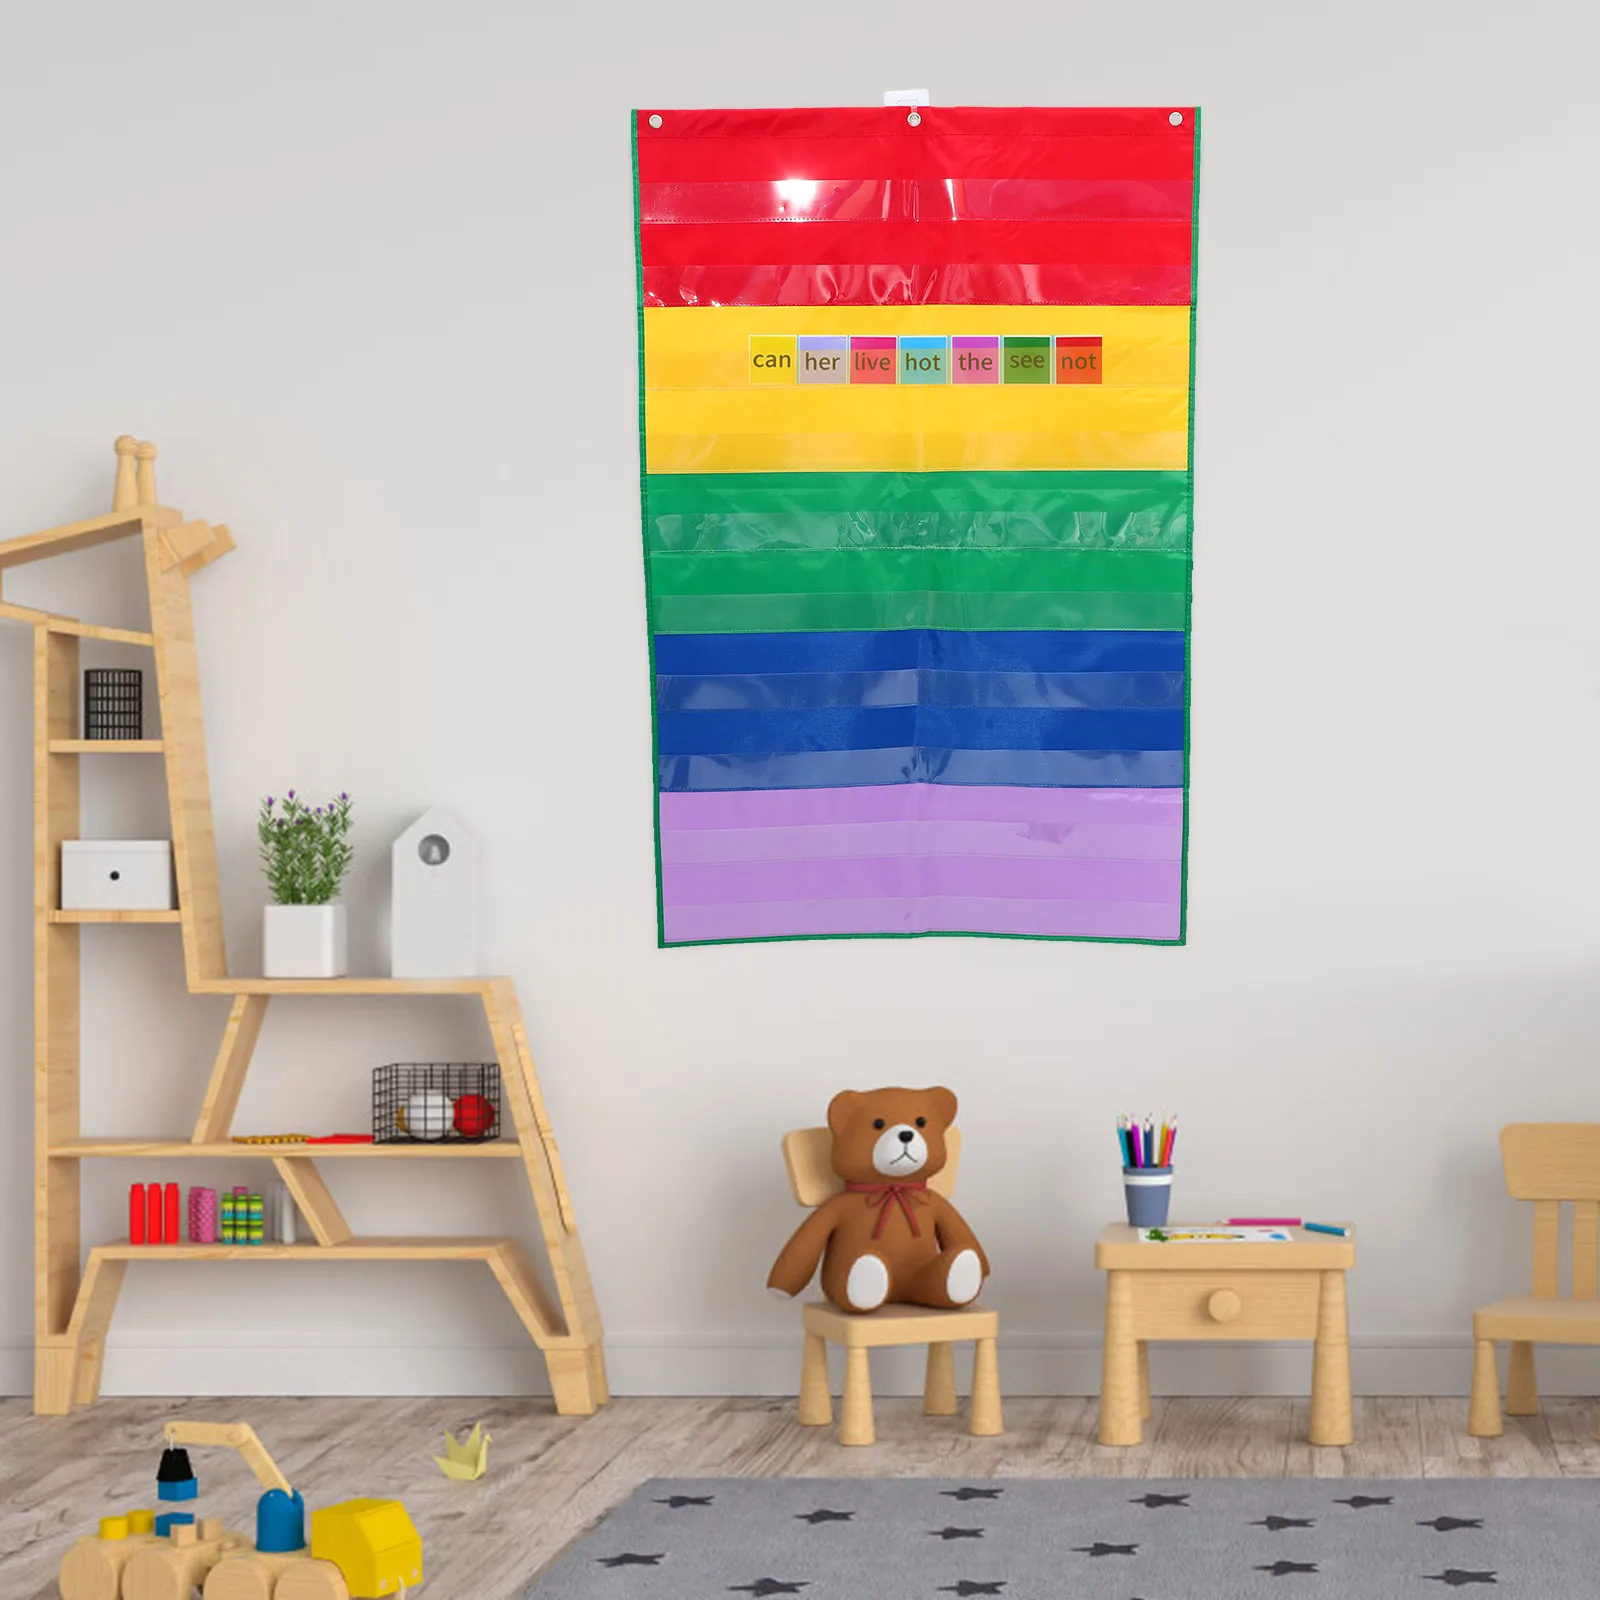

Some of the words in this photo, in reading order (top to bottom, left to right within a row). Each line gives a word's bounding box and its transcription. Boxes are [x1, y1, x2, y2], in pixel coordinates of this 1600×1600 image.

[753, 352, 791, 369] can
[804, 351, 841, 371] her
[854, 351, 891, 371] live
[905, 352, 941, 371] hot
[958, 352, 993, 371] the
[1009, 352, 1045, 369] see
[1061, 353, 1097, 371] not
